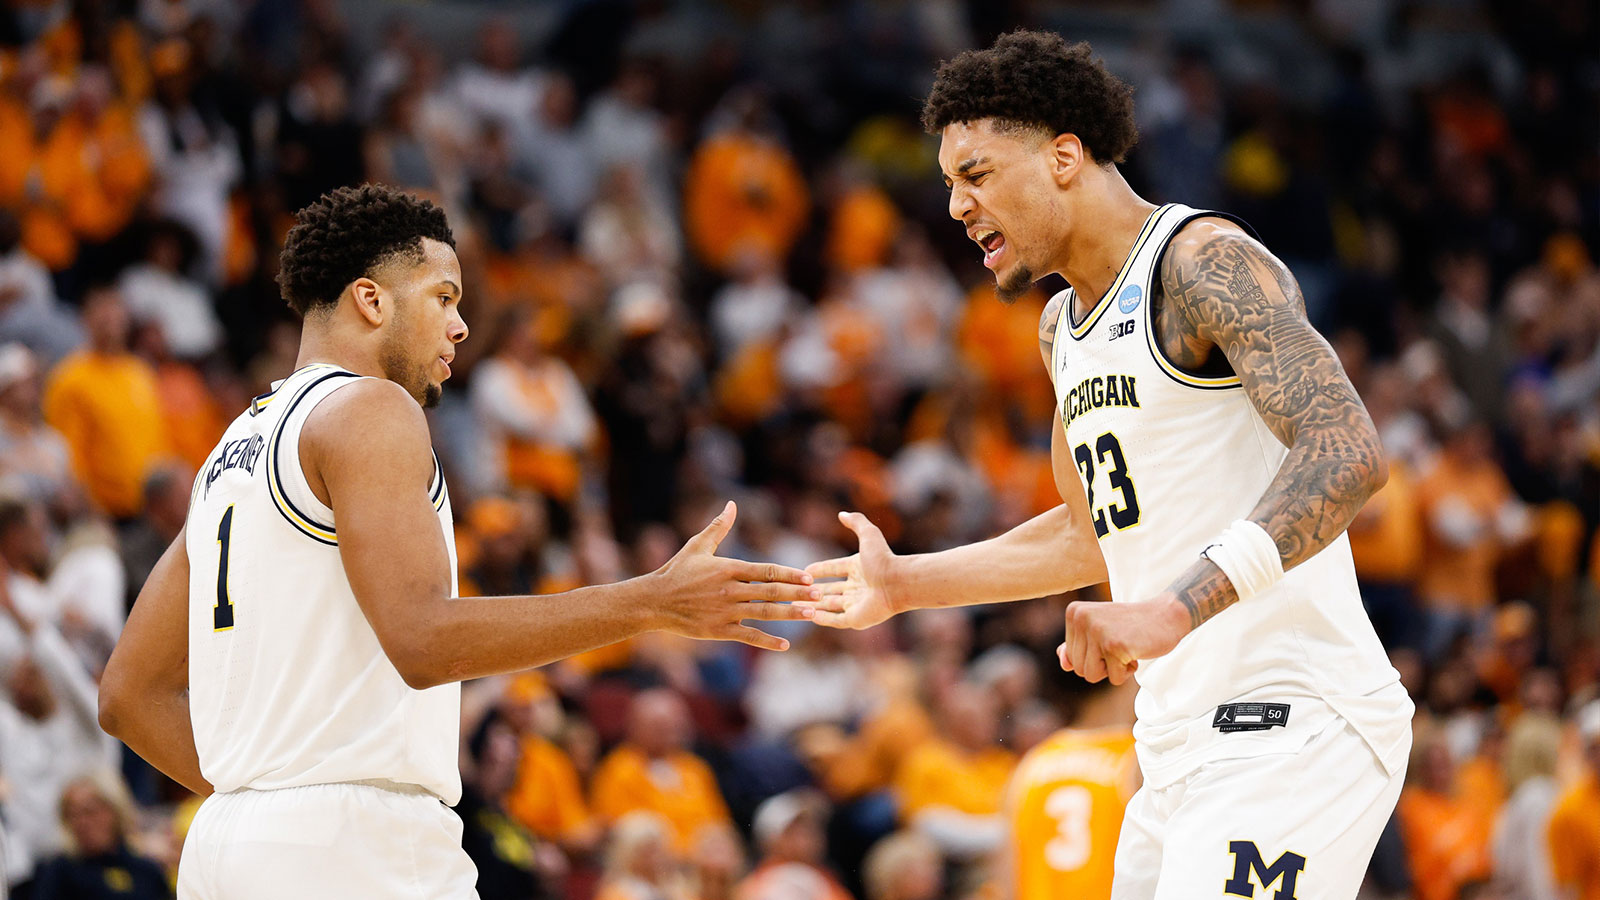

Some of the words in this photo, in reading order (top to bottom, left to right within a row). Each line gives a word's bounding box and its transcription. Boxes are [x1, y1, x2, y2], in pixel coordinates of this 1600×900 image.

[1074, 430, 1142, 540] 23
[213, 502, 235, 633] 1
[1268, 709, 1282, 719] 50
[1043, 784, 1093, 872] 3
[1223, 840, 1307, 900] M
